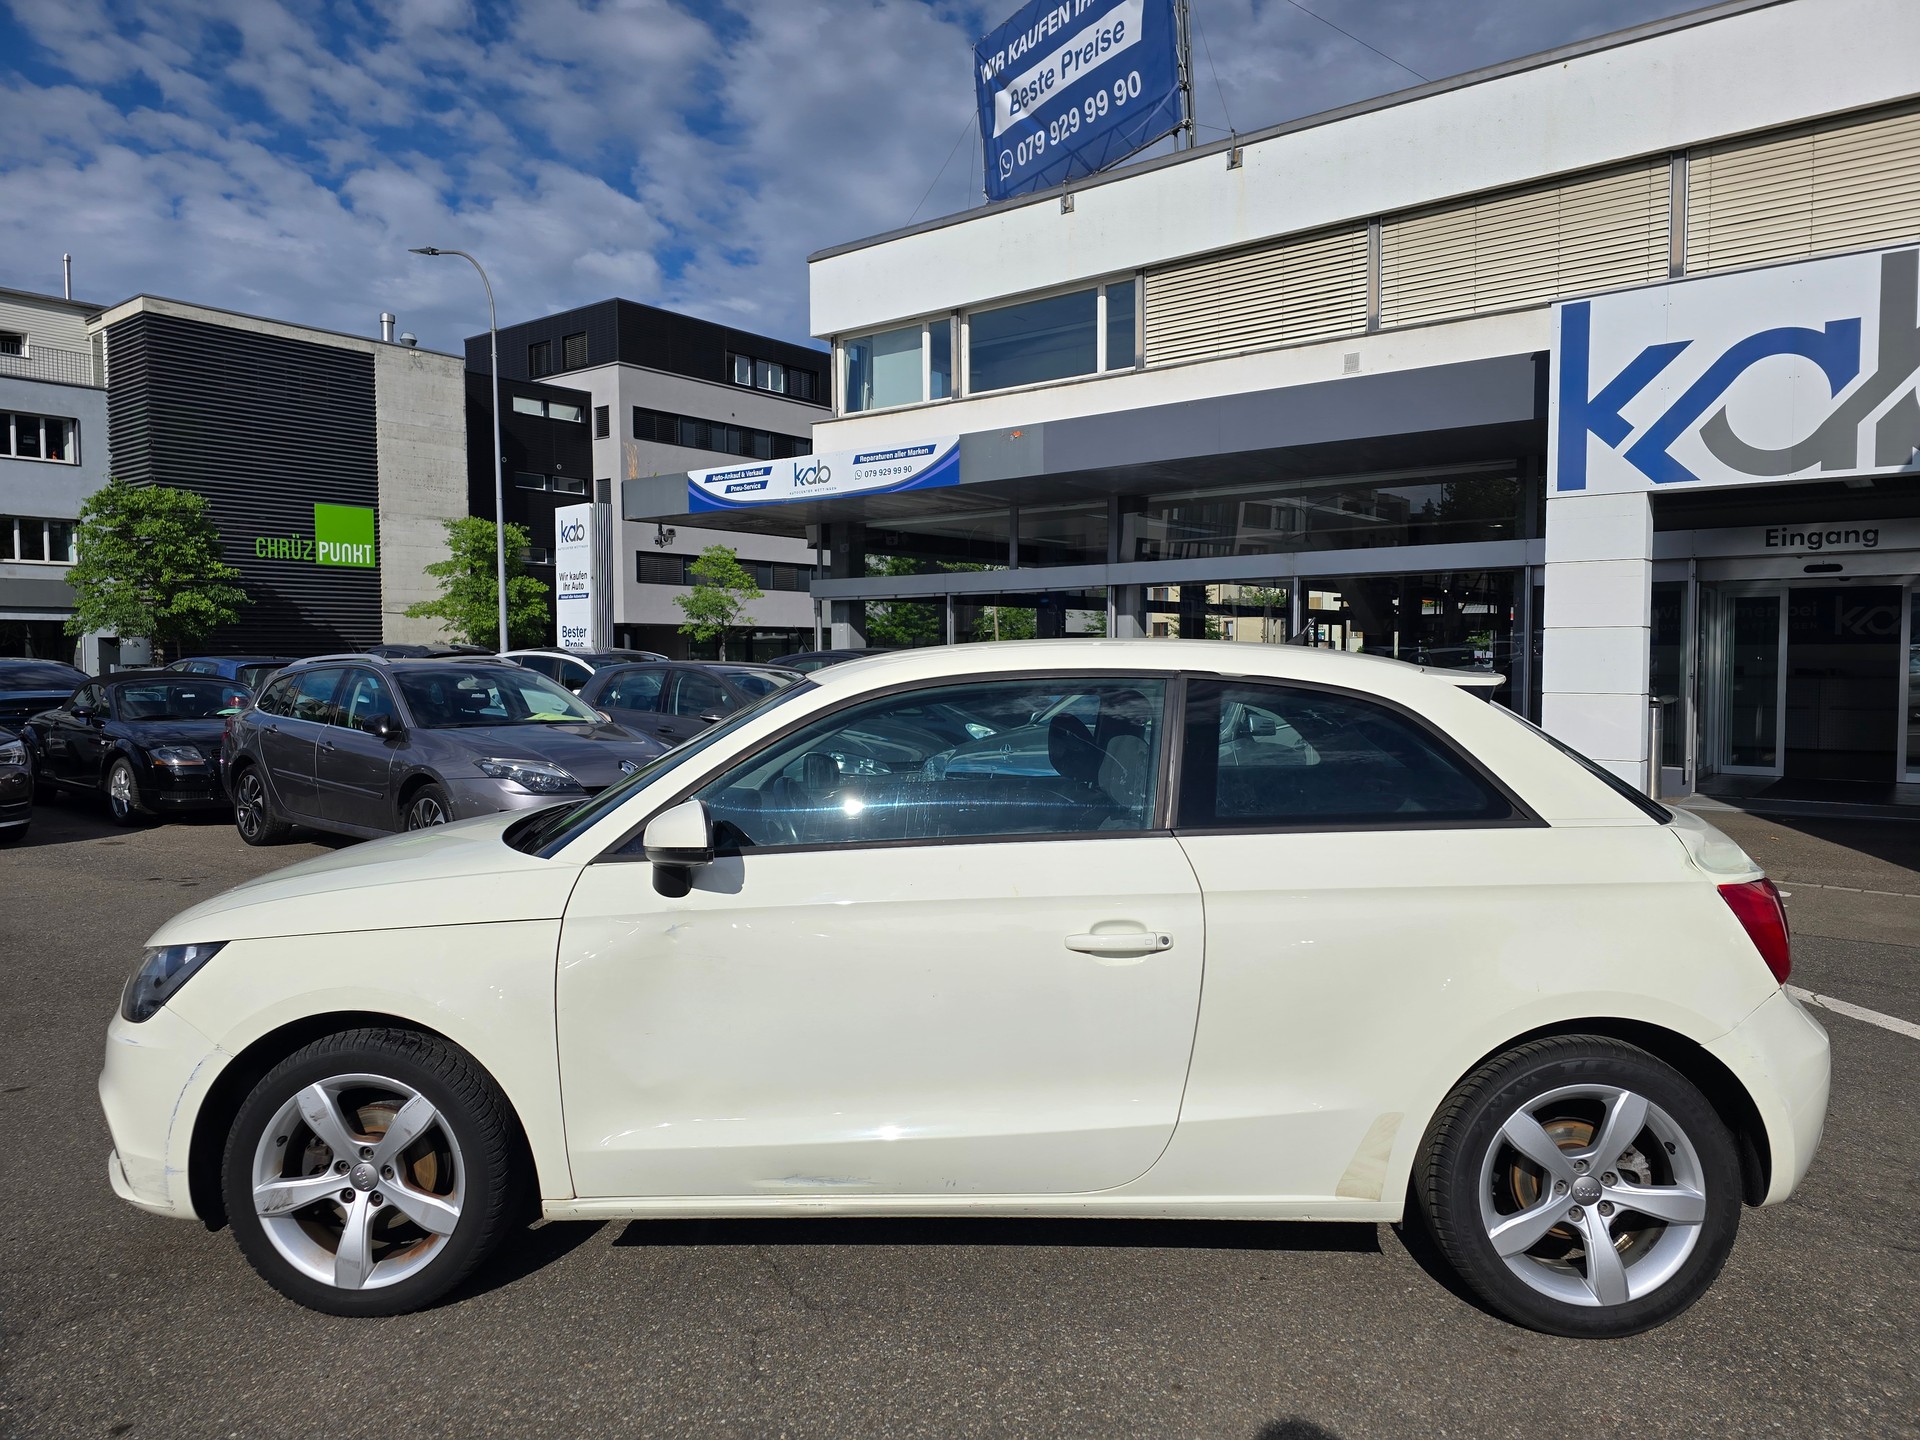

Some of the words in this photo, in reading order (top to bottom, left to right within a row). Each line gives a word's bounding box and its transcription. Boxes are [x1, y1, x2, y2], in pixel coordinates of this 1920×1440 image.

[980, 51, 1005, 84] WIR
[1008, 1, 1070, 65] KAUFEN
[1010, 66, 1055, 117] Beste
[1061, 20, 1125, 80] Preise
[1017, 130, 1045, 166] 079
[1049, 107, 1080, 146] 929
[1084, 90, 1109, 124] 99
[1113, 70, 1142, 107] 90
[859, 454, 894, 463] Reparaturen
[894, 450, 907, 458] aller
[907, 447, 929, 456] Marken
[711, 473, 741, 482] Auto-Ankauf
[745, 468, 764, 477] Verkauf
[794, 459, 831, 487] kab
[864, 469, 877, 478] 079
[878, 467, 892, 476] 929
[893, 466, 902, 475] 99
[903, 465, 912, 473] 90
[730, 482, 761, 492] Pneu-Service
[561, 518, 585, 544] kab
[1764, 526, 1880, 551] Eingang
[255, 533, 314, 561] CHRÜZ
[559, 571, 569, 581] Wir
[569, 570, 588, 581] kaufen
[562, 582, 571, 591] Ihr
[571, 581, 585, 590] Auto
[562, 625, 587, 638] Bester
